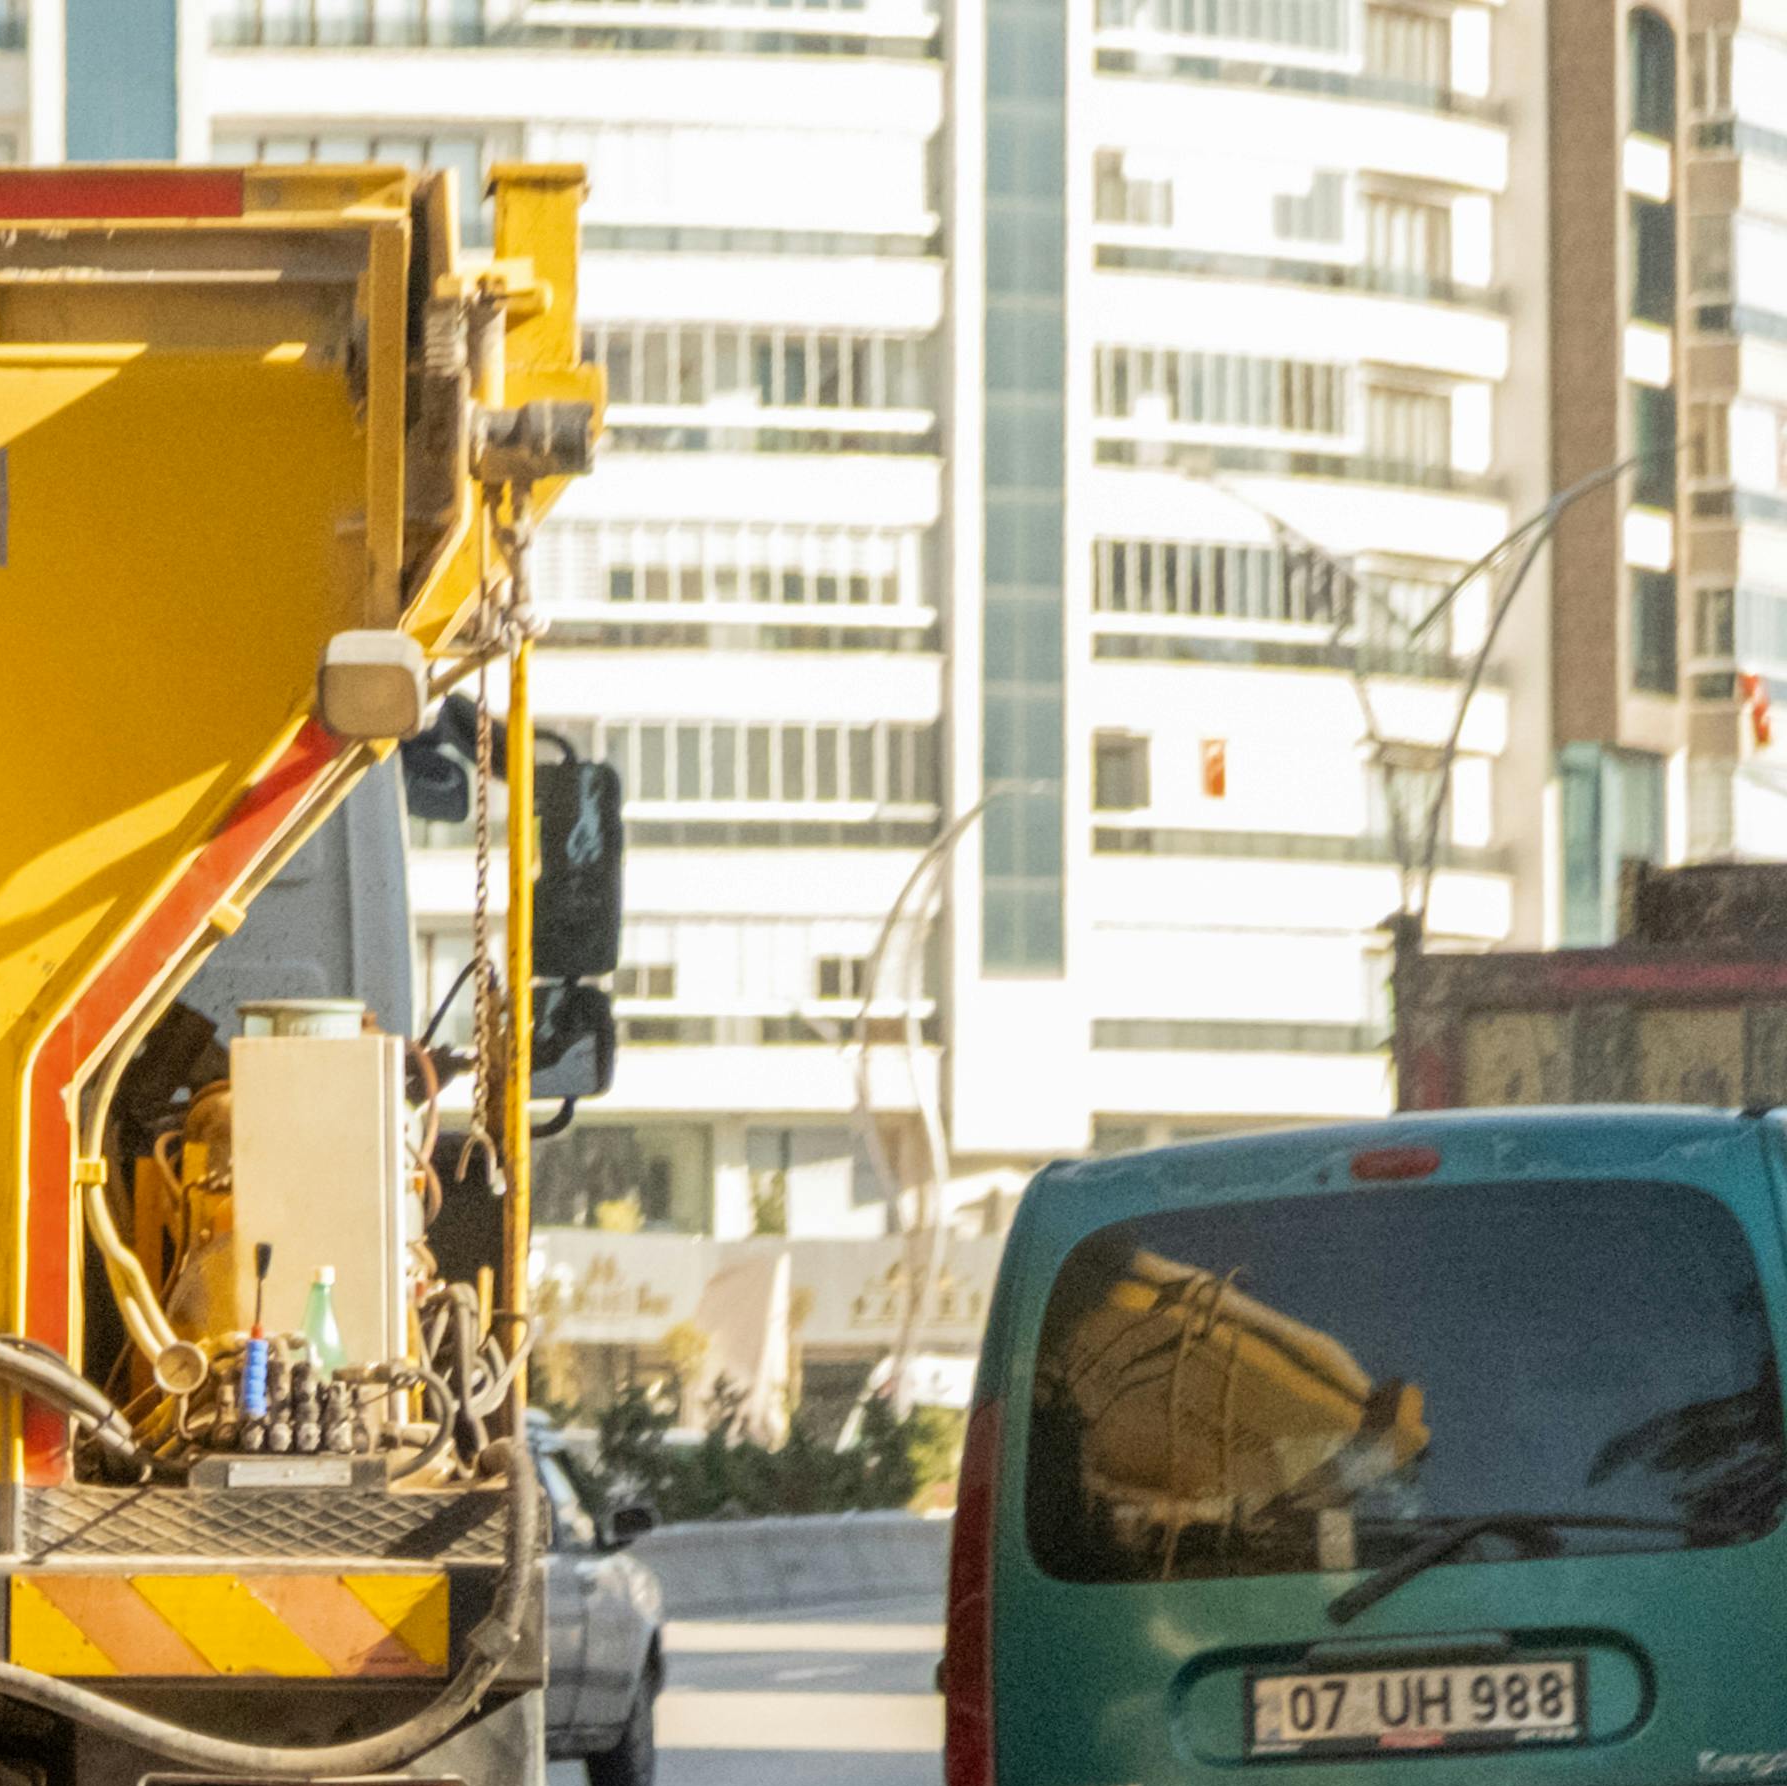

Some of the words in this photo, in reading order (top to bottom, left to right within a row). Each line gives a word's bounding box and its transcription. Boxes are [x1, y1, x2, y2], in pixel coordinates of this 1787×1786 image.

[1289, 1680, 1349, 1732] 07
[1377, 1674, 1452, 1728] UH
[1469, 1669, 1565, 1723] 988
